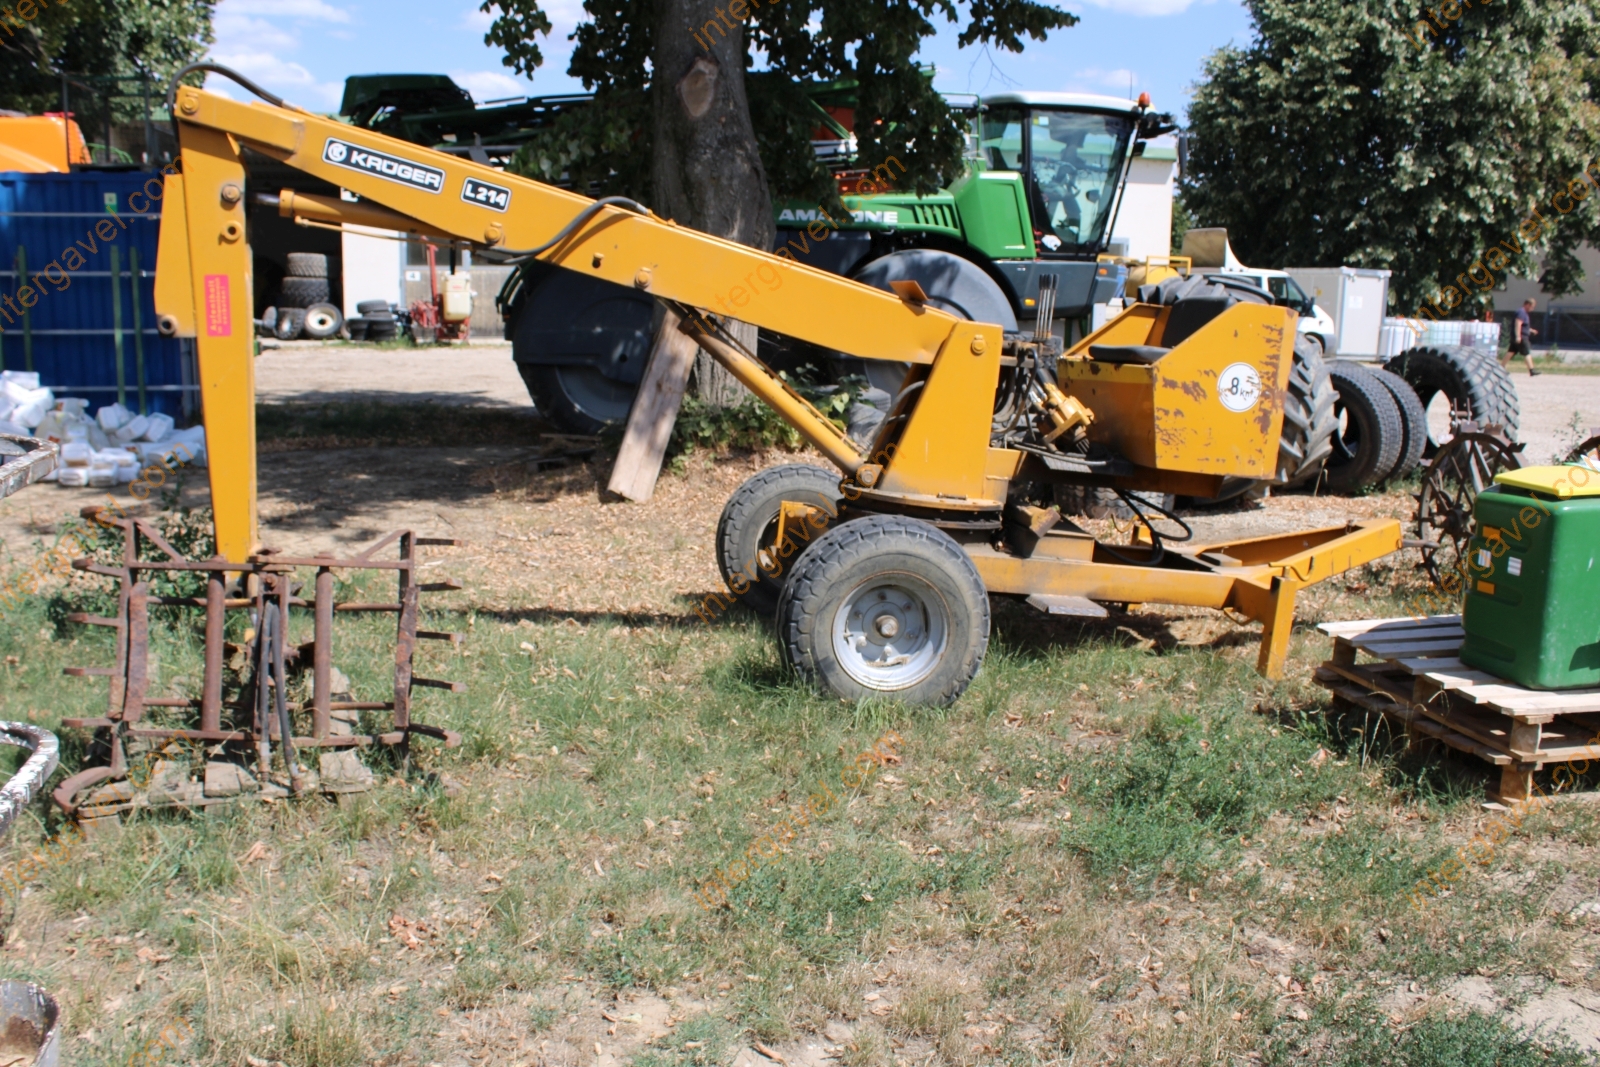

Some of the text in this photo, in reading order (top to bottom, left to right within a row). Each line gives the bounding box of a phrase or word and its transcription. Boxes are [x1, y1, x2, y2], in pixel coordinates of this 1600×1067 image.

[350, 150, 443, 188] KRÜGER
[778, 208, 898, 223] AMAONE
[1231, 376, 1239, 396] 8
